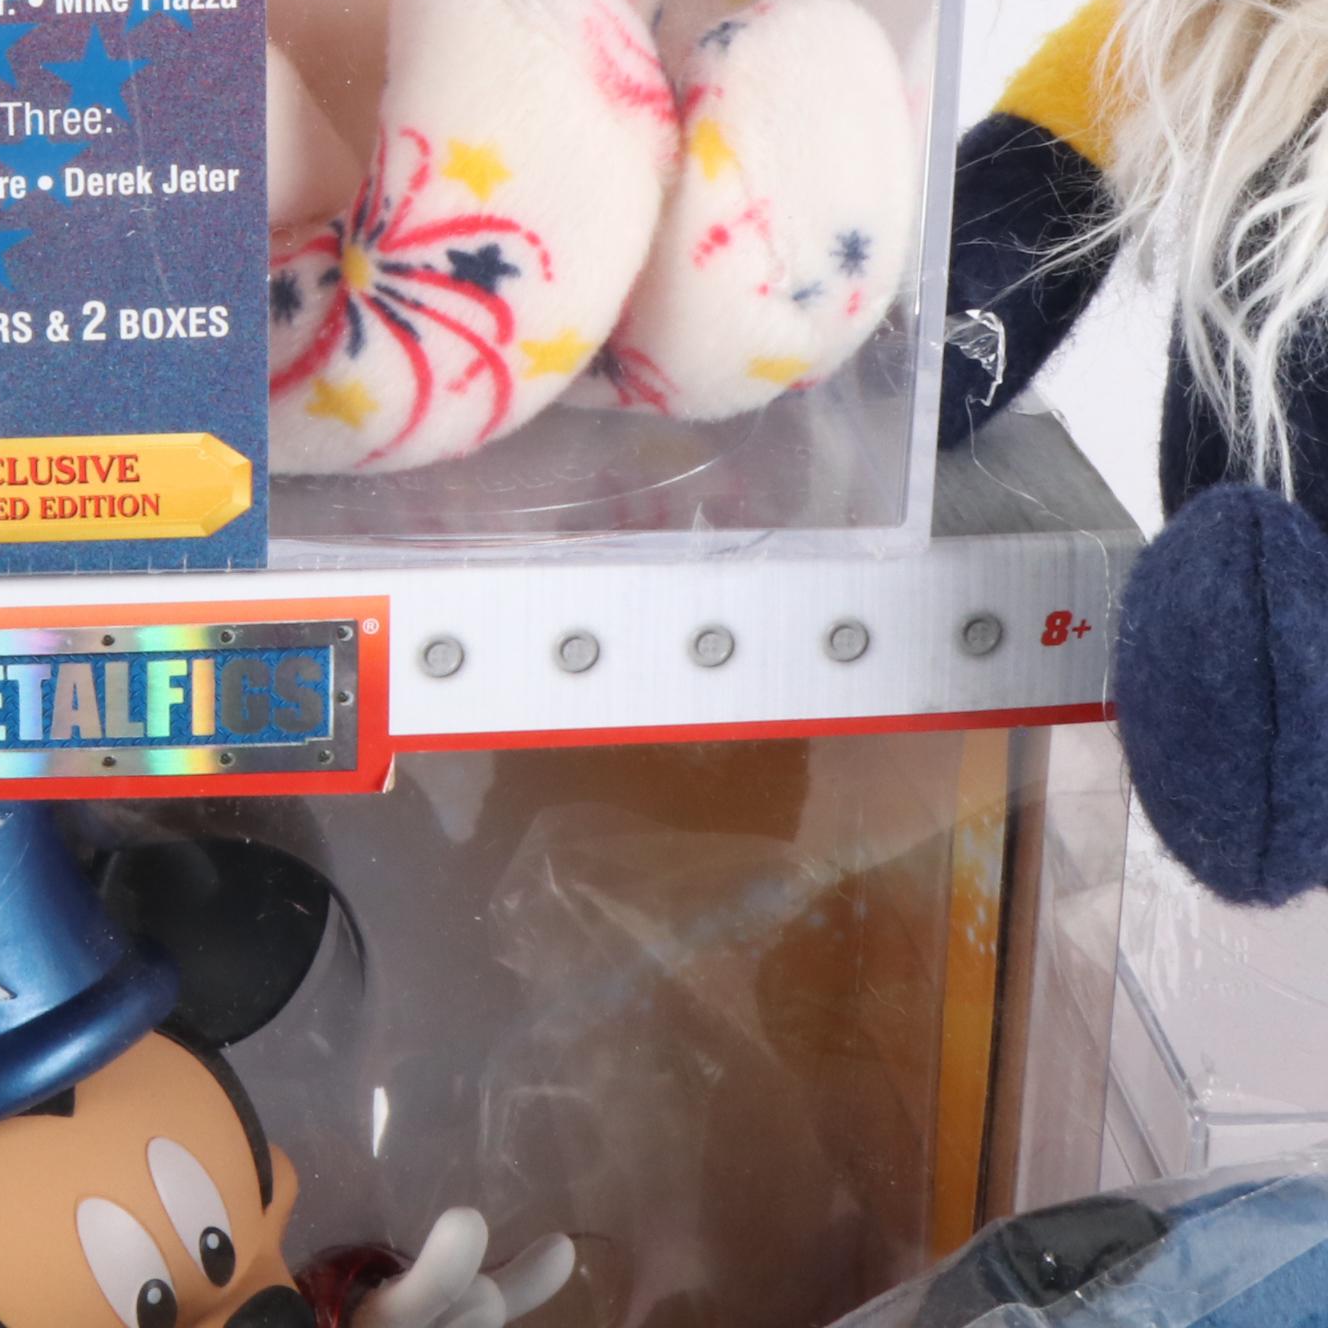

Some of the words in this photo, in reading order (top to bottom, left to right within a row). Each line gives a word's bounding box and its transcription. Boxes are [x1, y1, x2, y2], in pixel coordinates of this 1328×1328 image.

[64, 165, 153, 198] Derek
[162, 163, 241, 195] Jeter
[45, 310, 71, 344] &
[82, 300, 108, 342] 2
[119, 305, 230, 341] BOXES
[40, 493, 161, 521] EDITION
[1040, 609, 1092, 648] 8+
